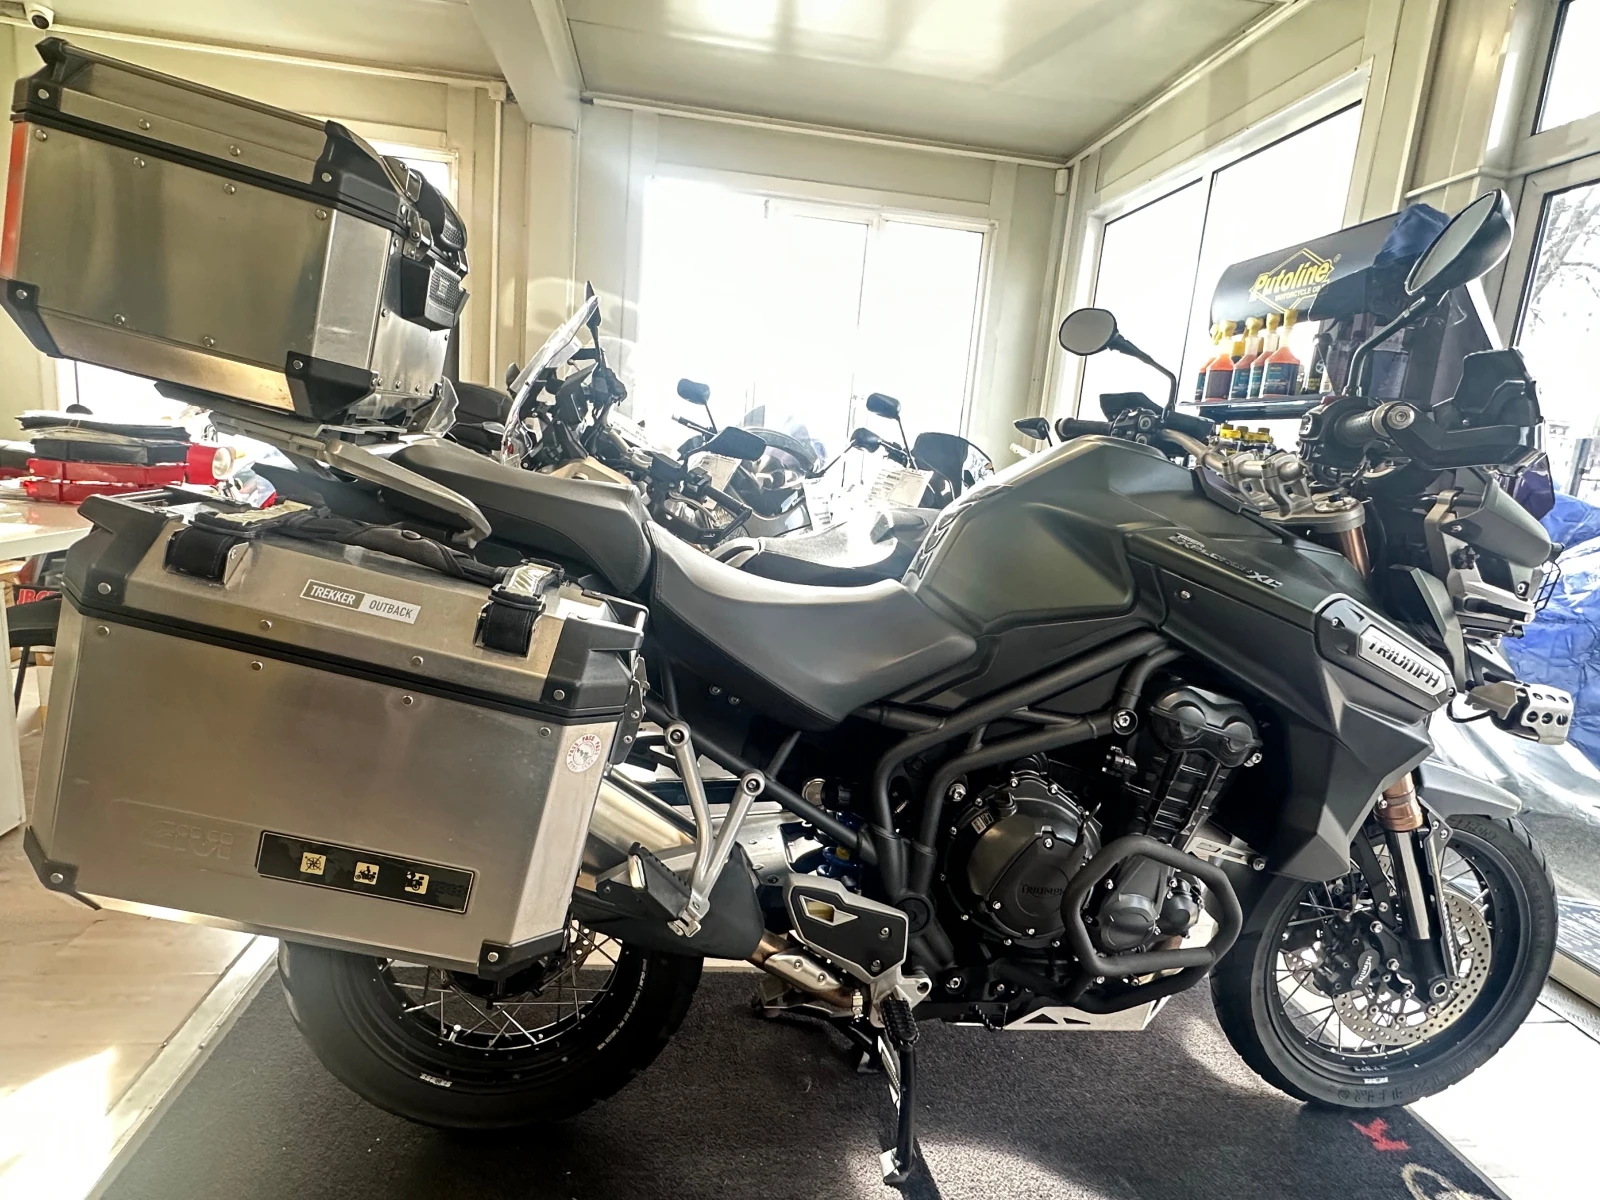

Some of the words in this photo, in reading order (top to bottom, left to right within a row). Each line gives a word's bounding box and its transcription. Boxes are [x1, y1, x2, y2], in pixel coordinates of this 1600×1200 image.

[1249, 262, 1331, 302] Putoline
[310, 585, 356, 606] TREKKER
[369, 600, 413, 619] OUTBACK
[1368, 635, 1441, 688] TRIUMPH
[1355, 955, 1373, 986] TRIUMPH
